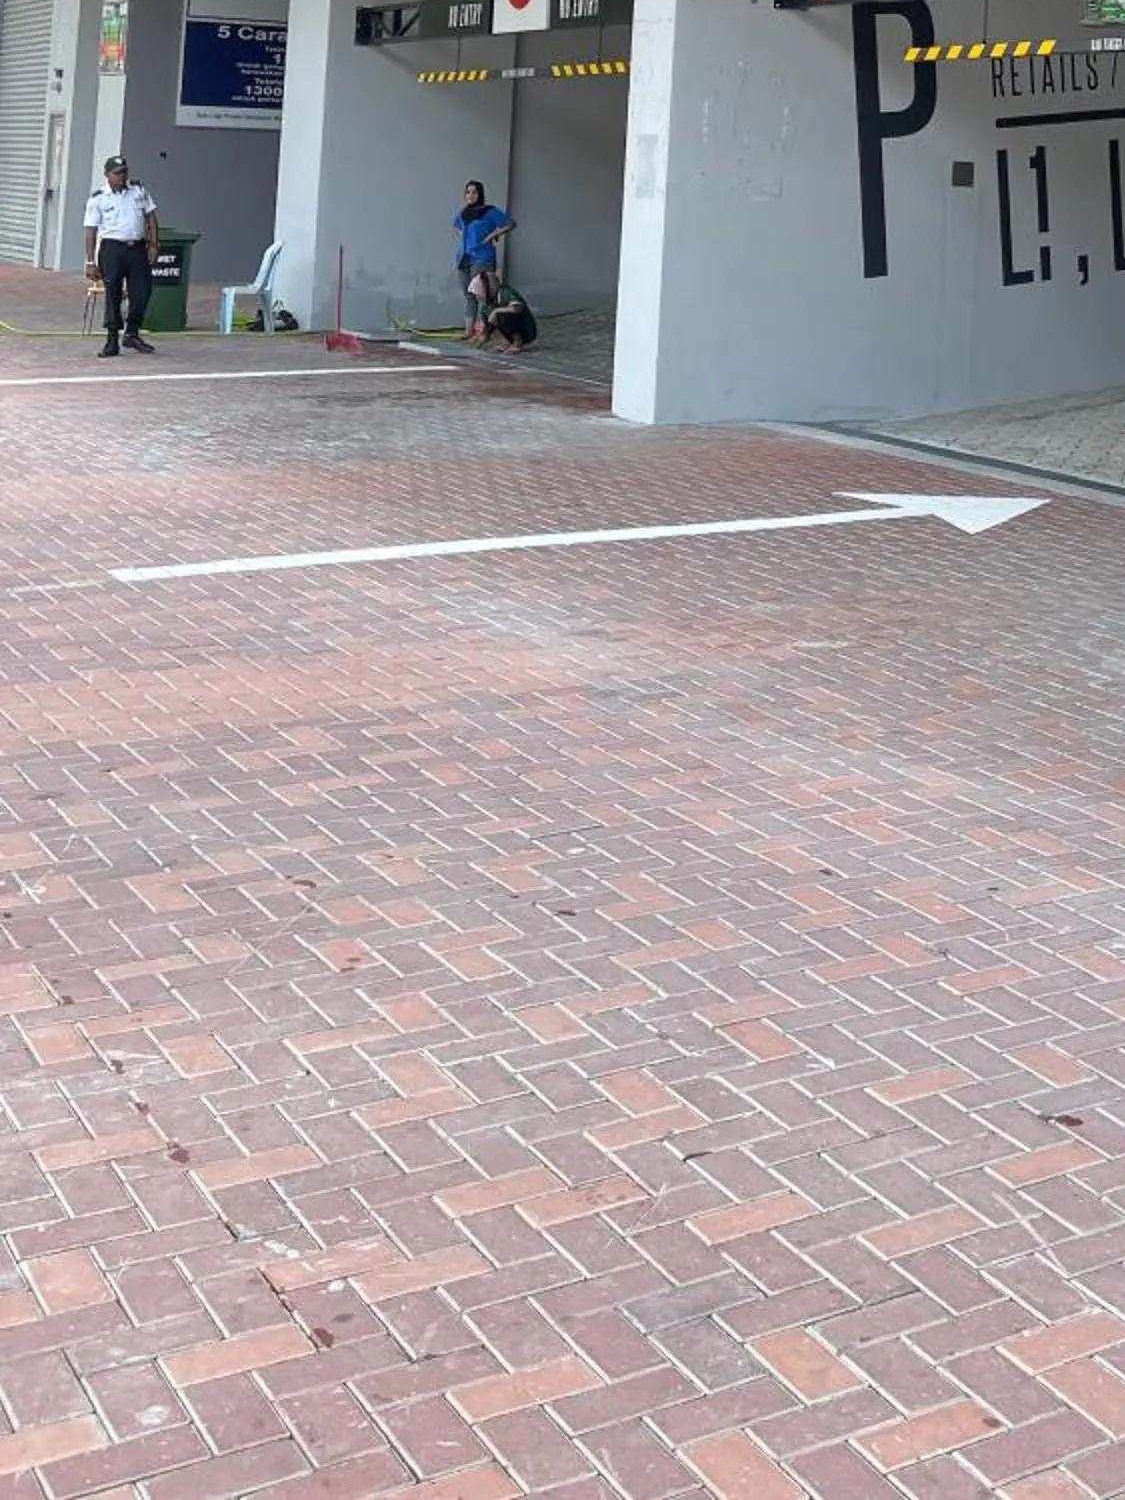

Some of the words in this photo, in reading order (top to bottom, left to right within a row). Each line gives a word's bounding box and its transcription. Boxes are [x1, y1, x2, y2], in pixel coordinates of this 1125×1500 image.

[217, 25, 231, 39] 5
[991, 52, 1098, 98] RETAILS
[851, 0, 937, 278] P
